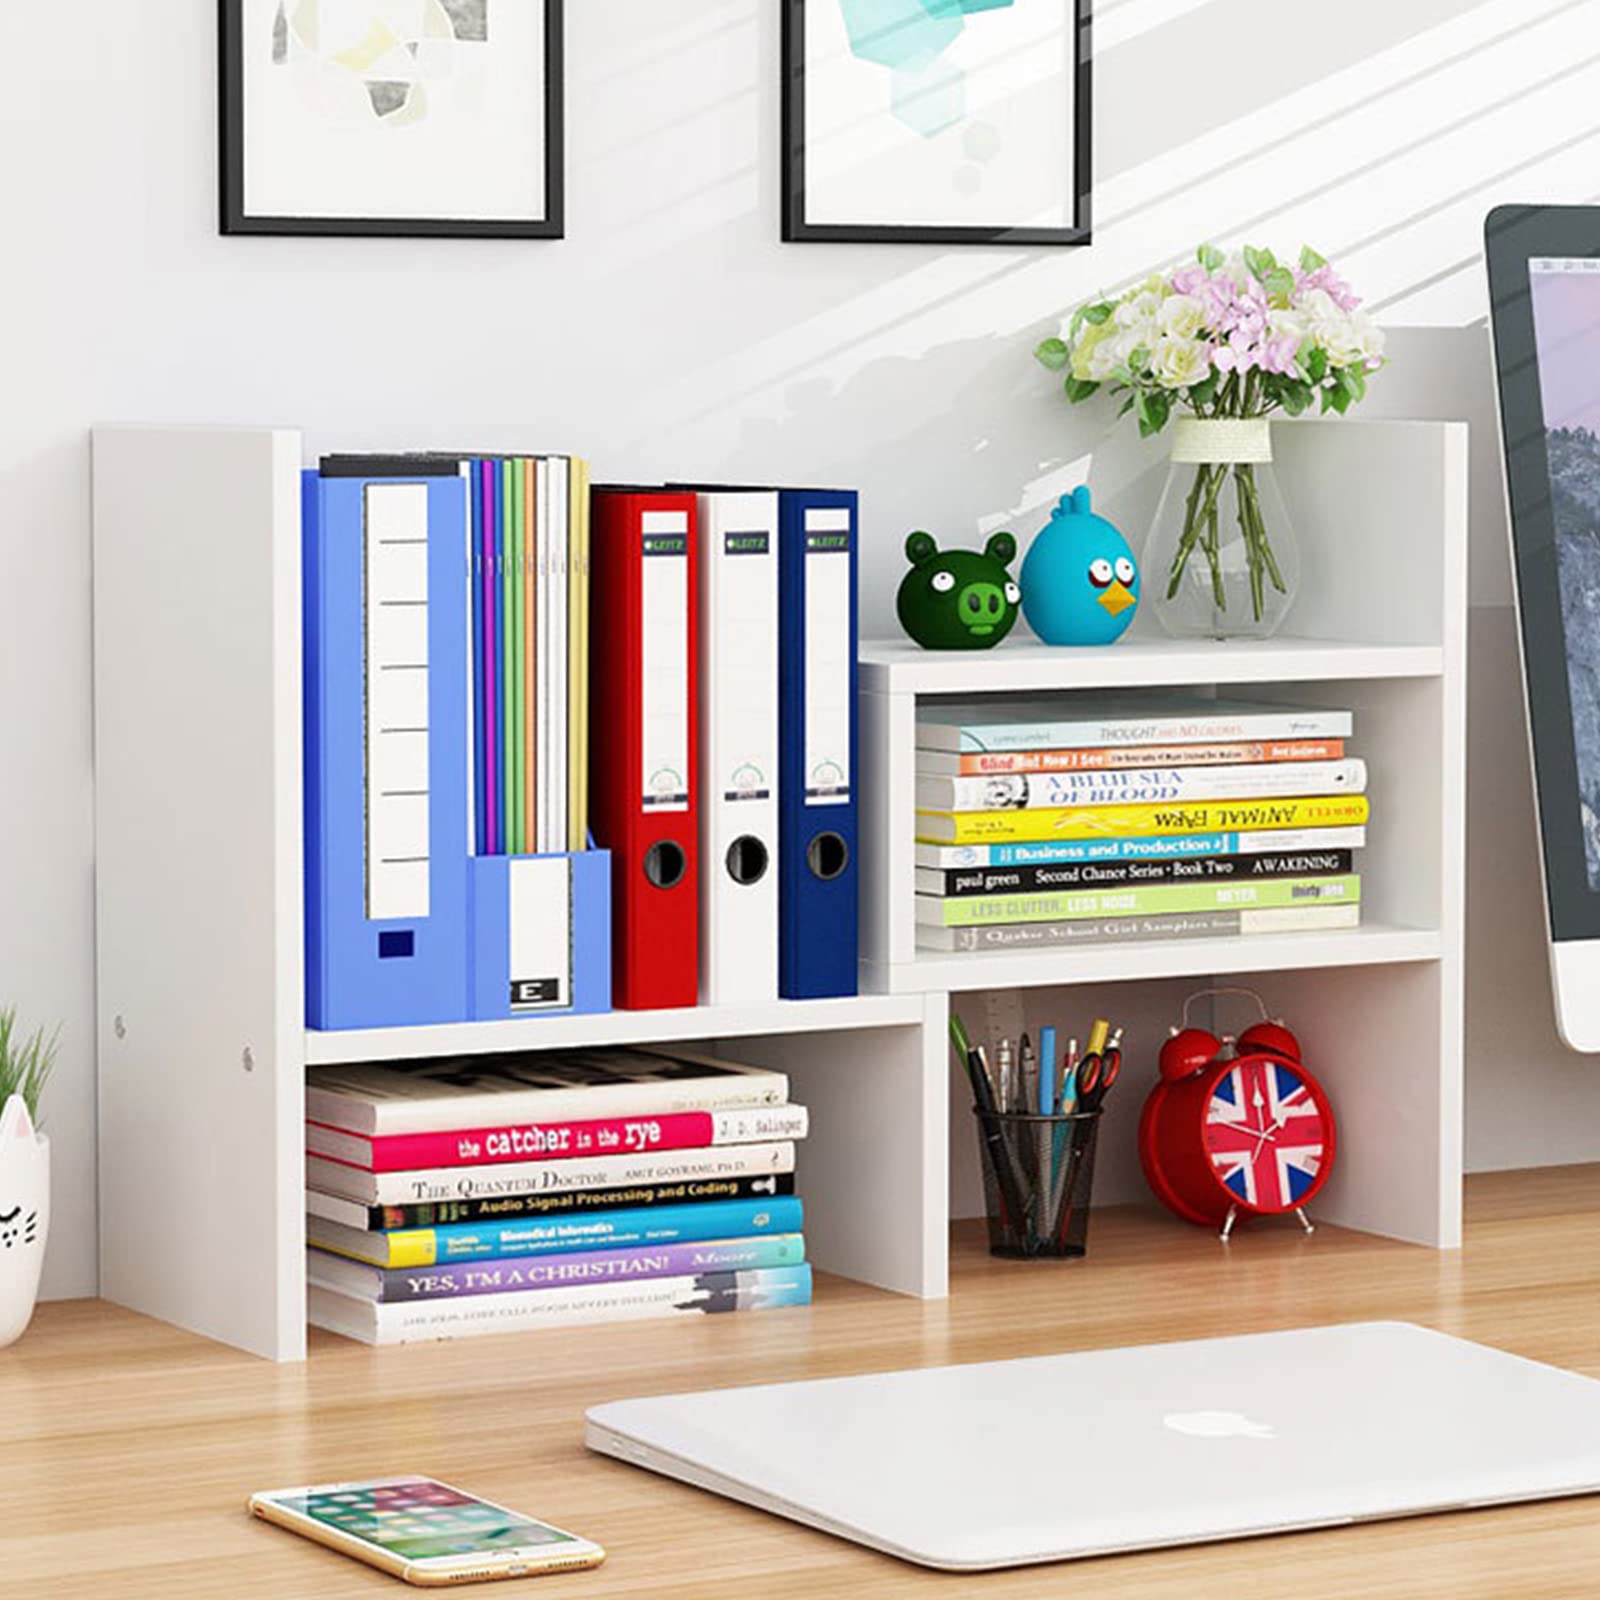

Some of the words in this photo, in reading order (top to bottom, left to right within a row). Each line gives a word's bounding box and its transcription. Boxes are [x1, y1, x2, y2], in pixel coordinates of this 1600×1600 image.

[1101, 726, 1157, 741] THOUGHT
[1042, 754, 1069, 767] Now
[1080, 753, 1104, 766] See
[1048, 776, 1061, 789] A
[1069, 773, 1128, 788] BLUE
[1139, 771, 1183, 785] SEA
[1050, 791, 1078, 803] OF
[1090, 787, 1179, 802] BLOOD
[1154, 809, 1208, 829] FARM
[1216, 805, 1297, 827] ANIMAL
[1015, 845, 1086, 860] Business
[1088, 843, 1119, 857] and
[1123, 839, 1211, 856] Production
[1035, 868, 1079, 884] Second
[1082, 865, 1127, 881] Chance
[1129, 863, 1164, 878] Series
[1173, 861, 1203, 876] Book
[1205, 860, 1234, 874] Two
[1253, 855, 1340, 874] AWAKENING
[956, 873, 983, 891] paul
[985, 874, 1020, 892] green
[971, 903, 1002, 918] LESS
[1050, 926, 1099, 938] School
[1104, 922, 1137, 935] Girl
[519, 982, 543, 1000] E
[755, 1118, 802, 1135] Salinger
[458, 1140, 480, 1158] the
[486, 1127, 571, 1156] catcher
[576, 1132, 592, 1148] in
[597, 1128, 619, 1147] the
[624, 1121, 661, 1150] rye
[412, 1180, 450, 1199] THE
[457, 1176, 536, 1199] QUANTUM
[541, 1171, 608, 1190] DOCTOR
[480, 1199, 523, 1214] Audio
[527, 1194, 573, 1212] Signal
[577, 1186, 654, 1206] Processing
[657, 1184, 686, 1199] and
[688, 1181, 739, 1197] Coding
[407, 1274, 459, 1294] YES,
[465, 1271, 501, 1288] I'M
[508, 1269, 524, 1285] A
[529, 1256, 670, 1282] CHRISTIAN!
